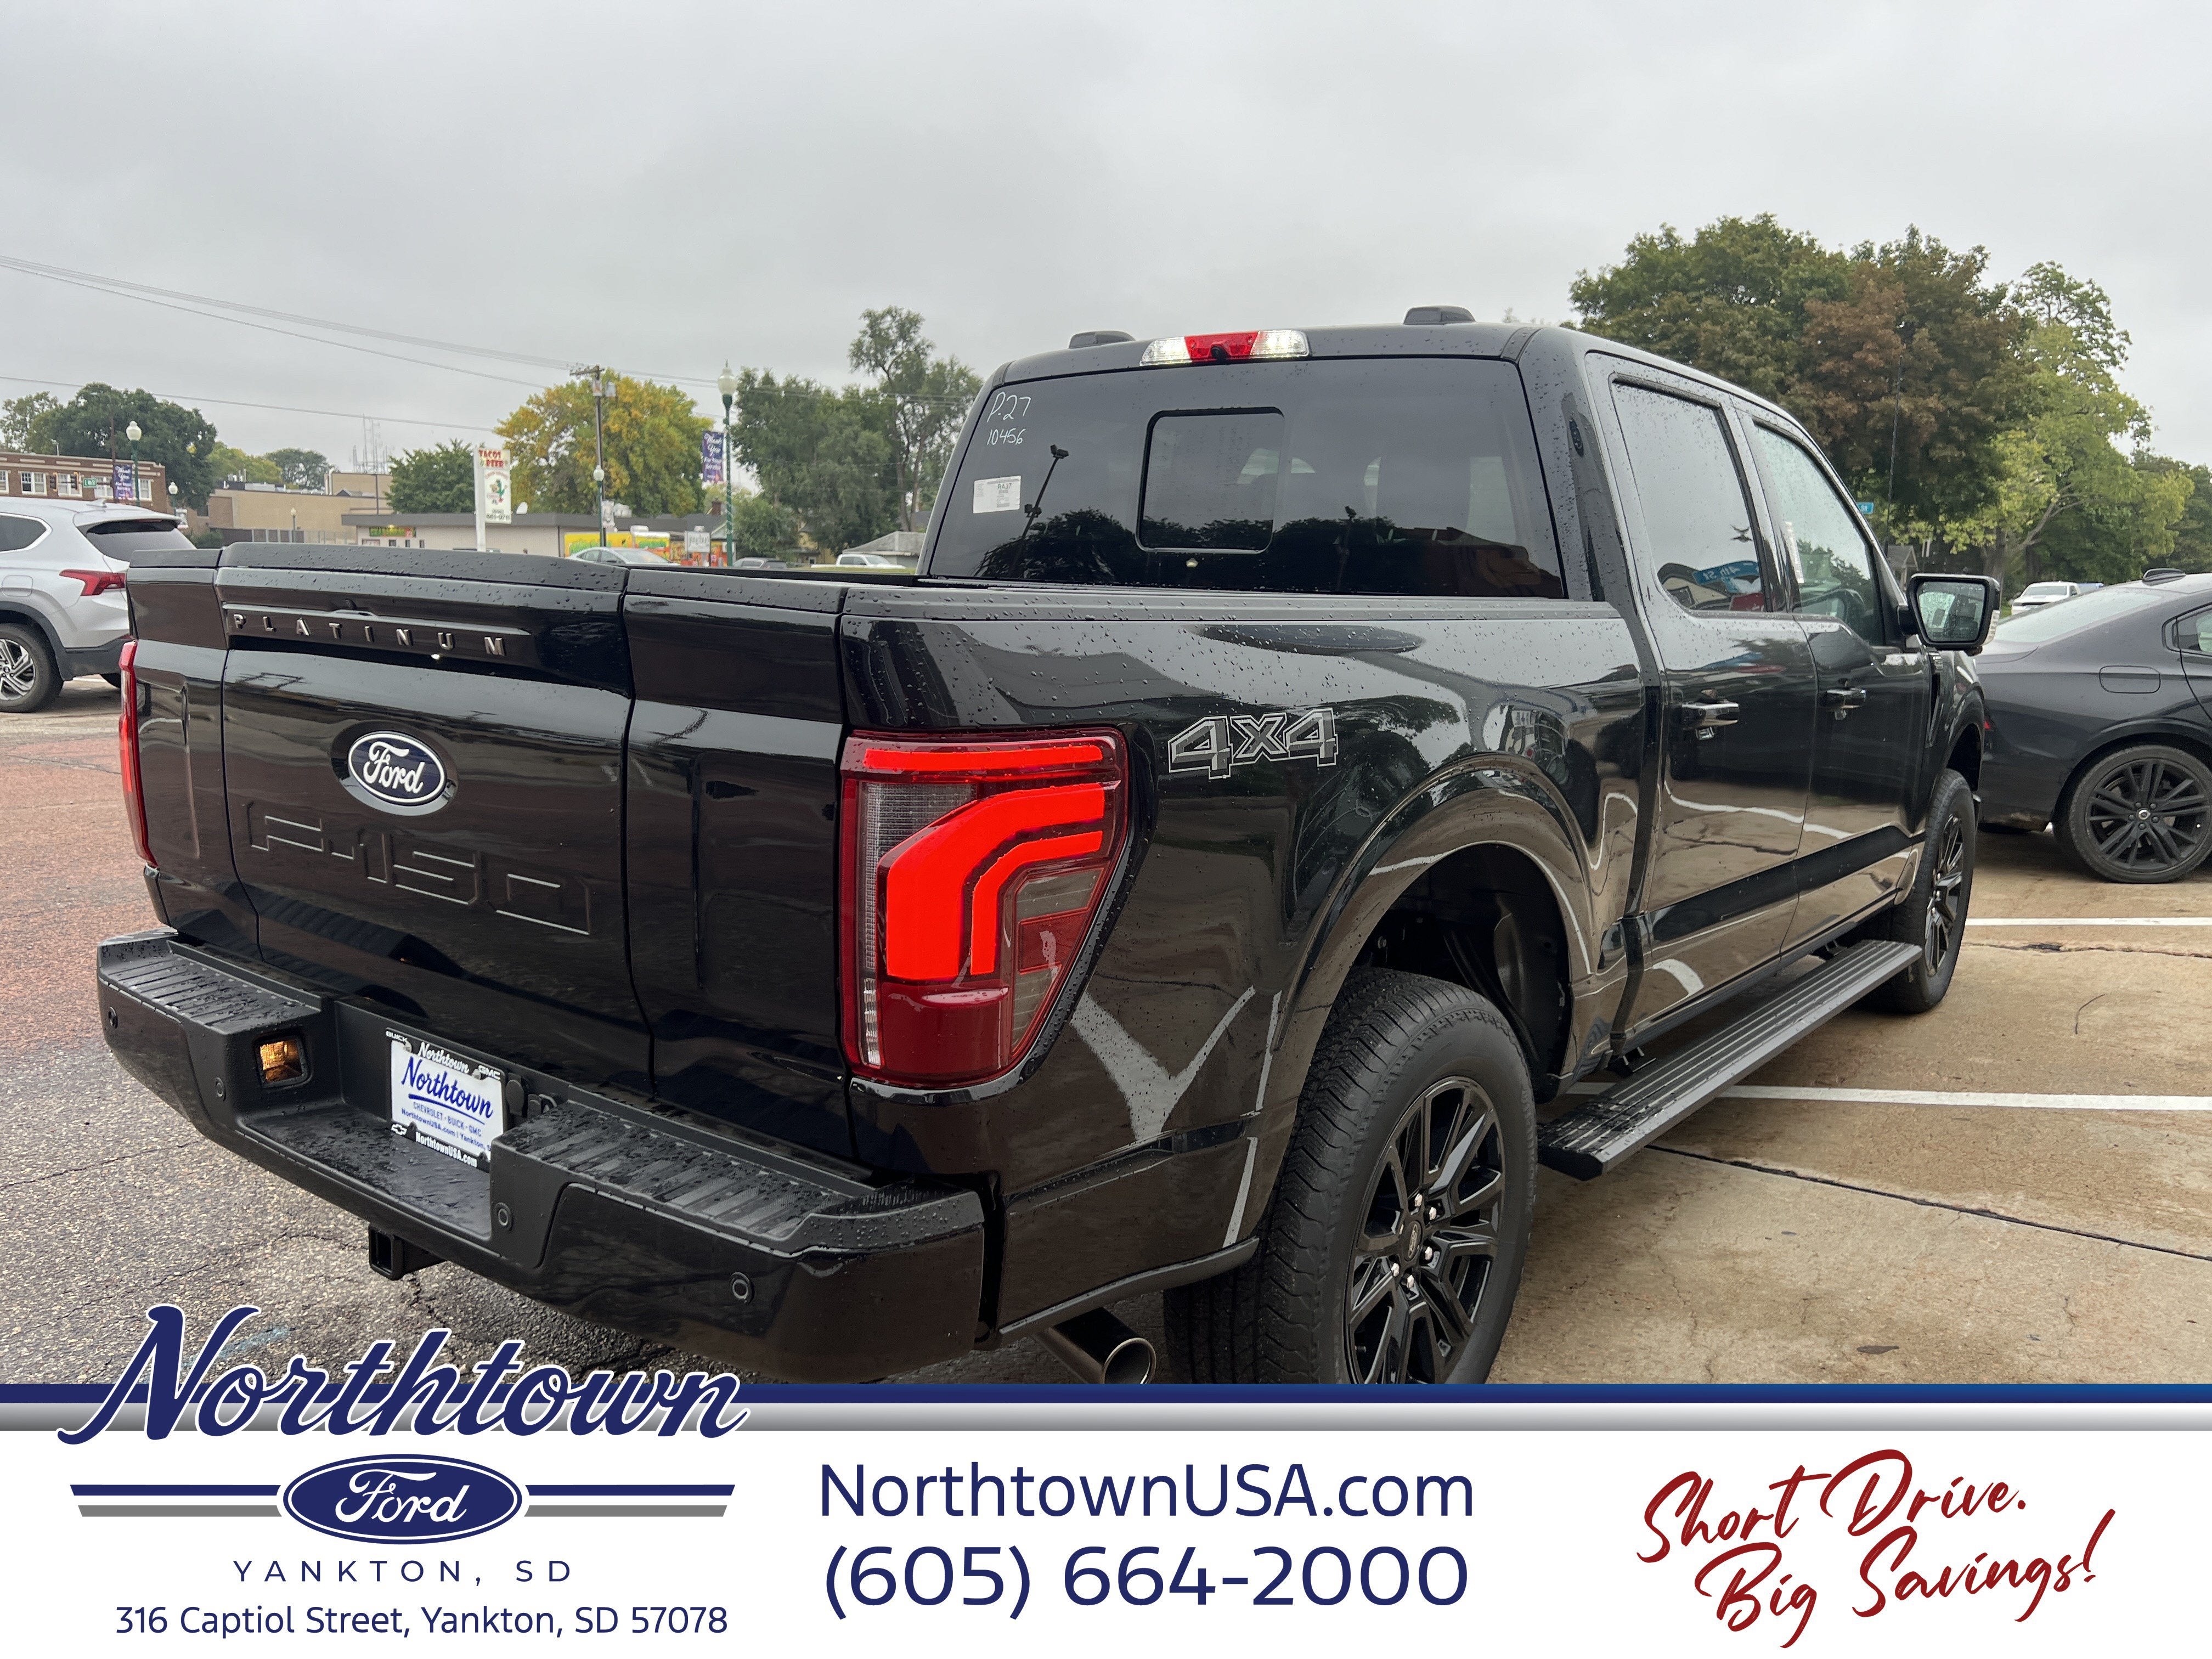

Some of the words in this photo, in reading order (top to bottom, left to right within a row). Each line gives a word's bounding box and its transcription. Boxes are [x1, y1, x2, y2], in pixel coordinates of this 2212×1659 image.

[987, 428, 1026, 445] 10456
[233, 613, 507, 657] PLATINUM
[363, 741, 426, 794] Ford
[245, 802, 591, 936] F-150
[386, 1030, 408, 1042] BUICK
[417, 1041, 470, 1074] Northtown
[478, 1065, 501, 1080] GMC
[401, 1056, 494, 1119] Northtown
[401, 1107, 456, 1137] NorthtownUSA.com
[413, 1102, 443, 1121] CHEVROLET
[447, 1116, 465, 1130] BUICK
[469, 1125, 482, 1137] GMC
[415, 1131, 477, 1167] NorthtownUSA.com
